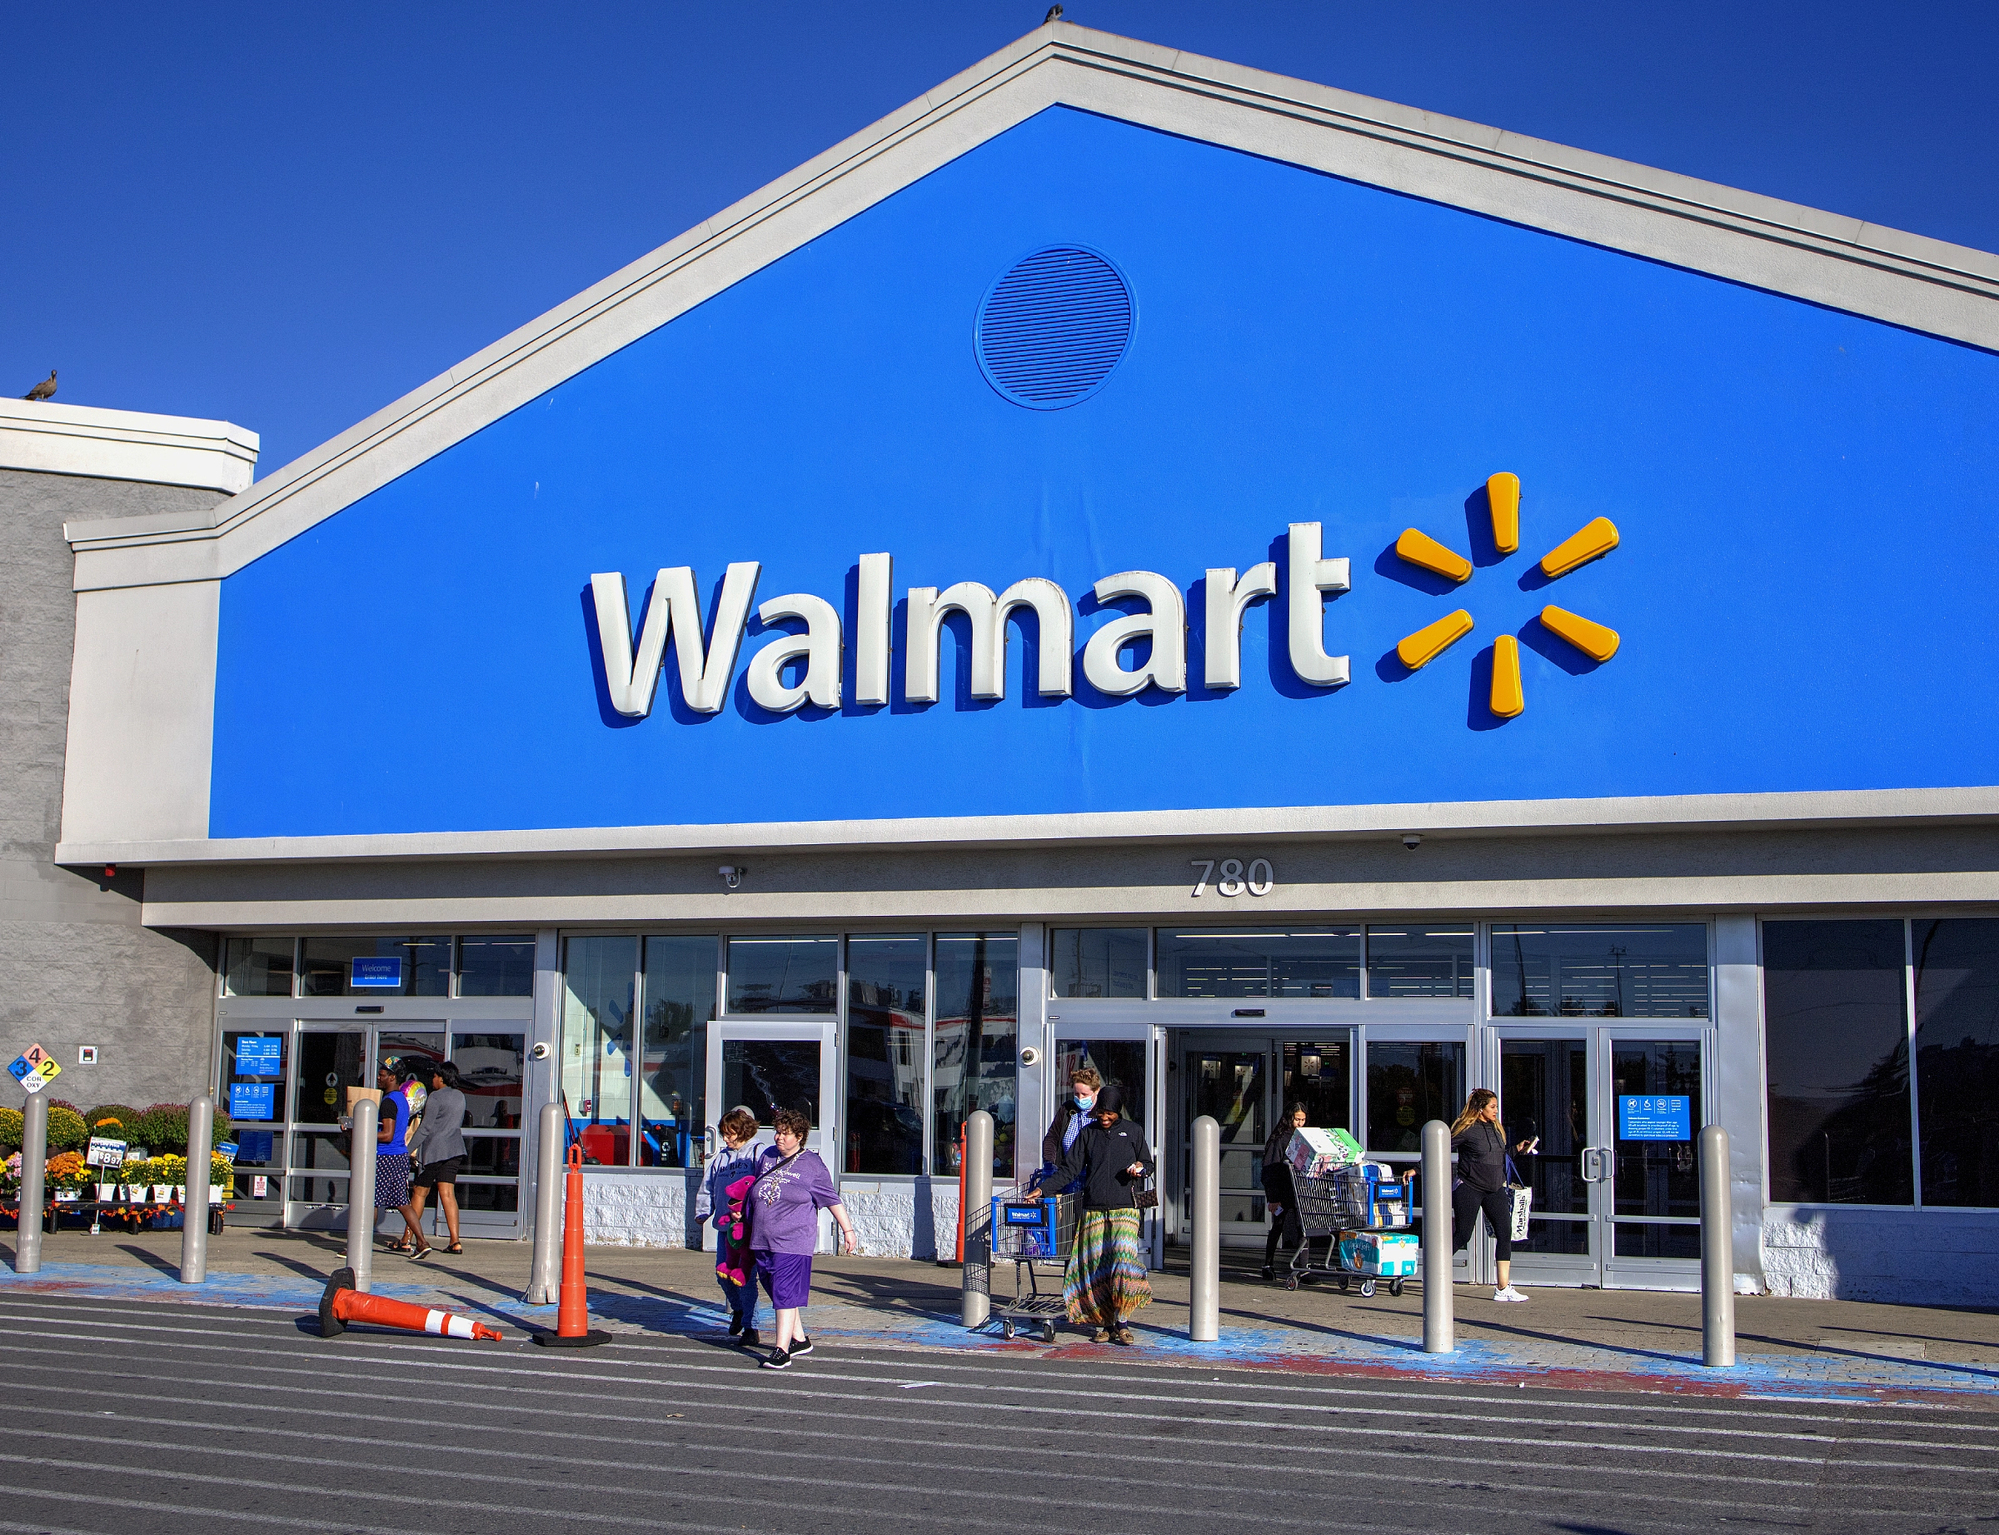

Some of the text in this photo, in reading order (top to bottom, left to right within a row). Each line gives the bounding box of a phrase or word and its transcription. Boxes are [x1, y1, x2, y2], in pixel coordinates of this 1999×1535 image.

[590, 521, 1351, 717] Walmart
[1190, 858, 1274, 897] 780
[361, 964, 392, 973] Welcome
[29, 1048, 41, 1063] 4
[15, 1061, 27, 1077] 3
[42, 1061, 54, 1076] 2
[1516, 1195, 1526, 1236] Marshalls
